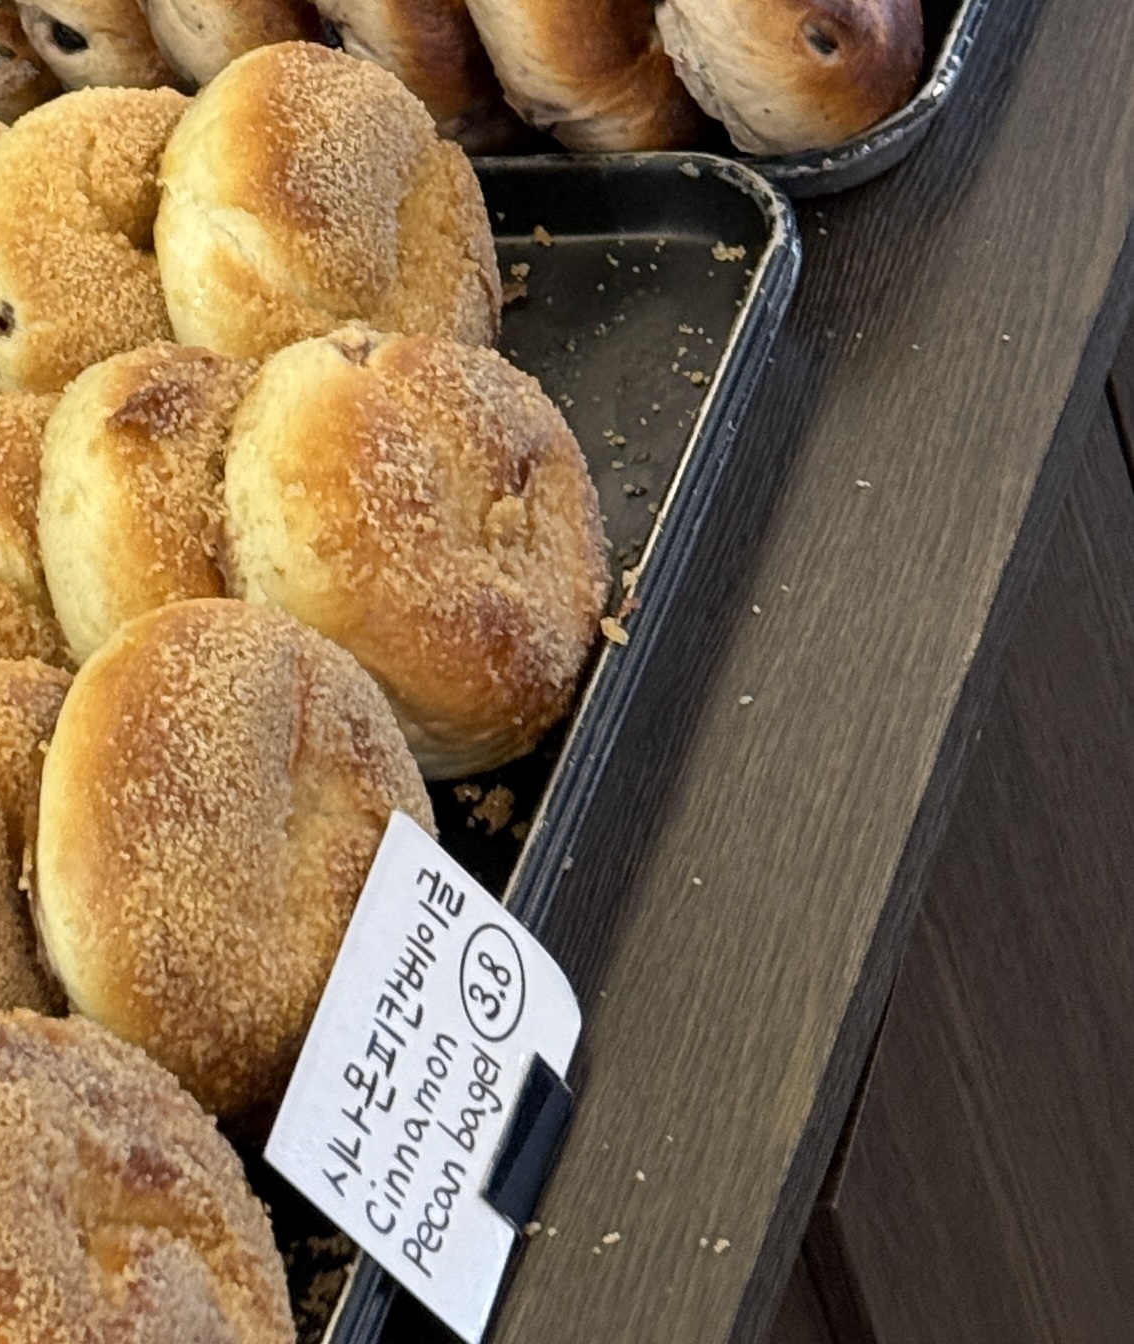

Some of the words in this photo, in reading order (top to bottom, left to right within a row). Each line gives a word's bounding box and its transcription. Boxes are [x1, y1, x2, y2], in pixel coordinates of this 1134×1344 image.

[322, 867, 464, 1198] 시나몬피칸베이글
[367, 1032, 458, 1236] Cinnamon
[468, 951, 512, 1021] 3.8
[439, 1042, 503, 1154] bagel
